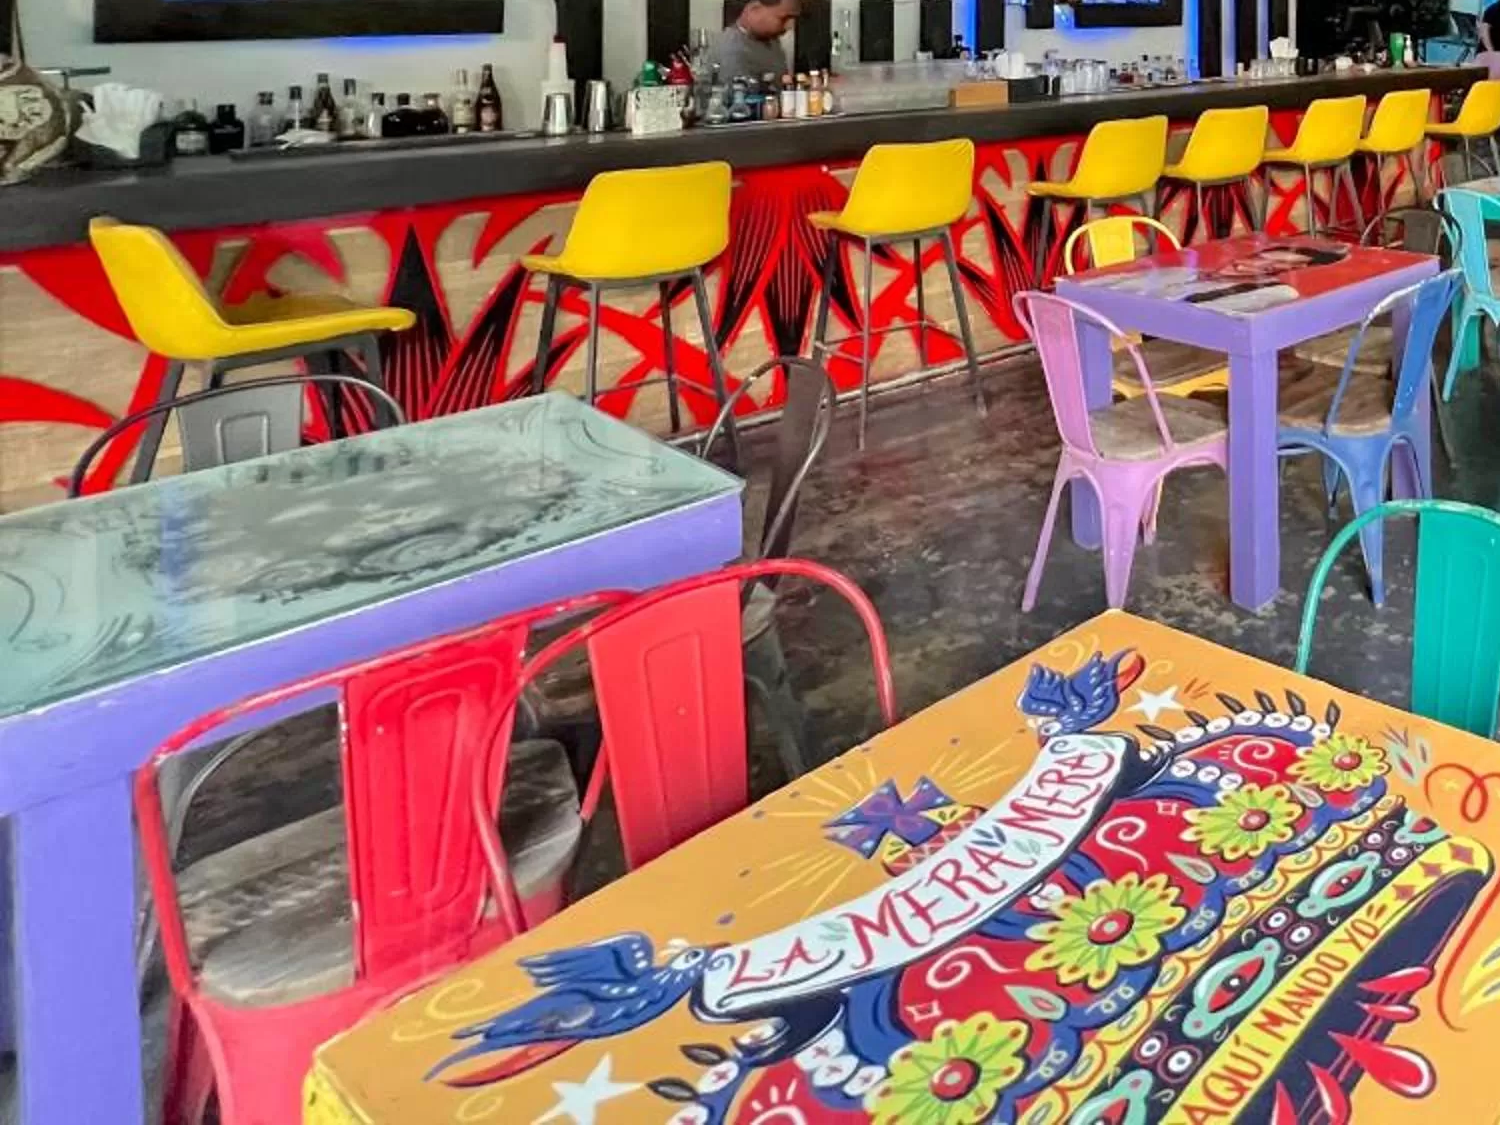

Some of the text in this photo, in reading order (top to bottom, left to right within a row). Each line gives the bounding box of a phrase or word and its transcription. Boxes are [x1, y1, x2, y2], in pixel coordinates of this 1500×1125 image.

[727, 747, 1117, 989] LA MERA MERA
[1180, 917, 1380, 1125] AQUÍ MANDO YO
